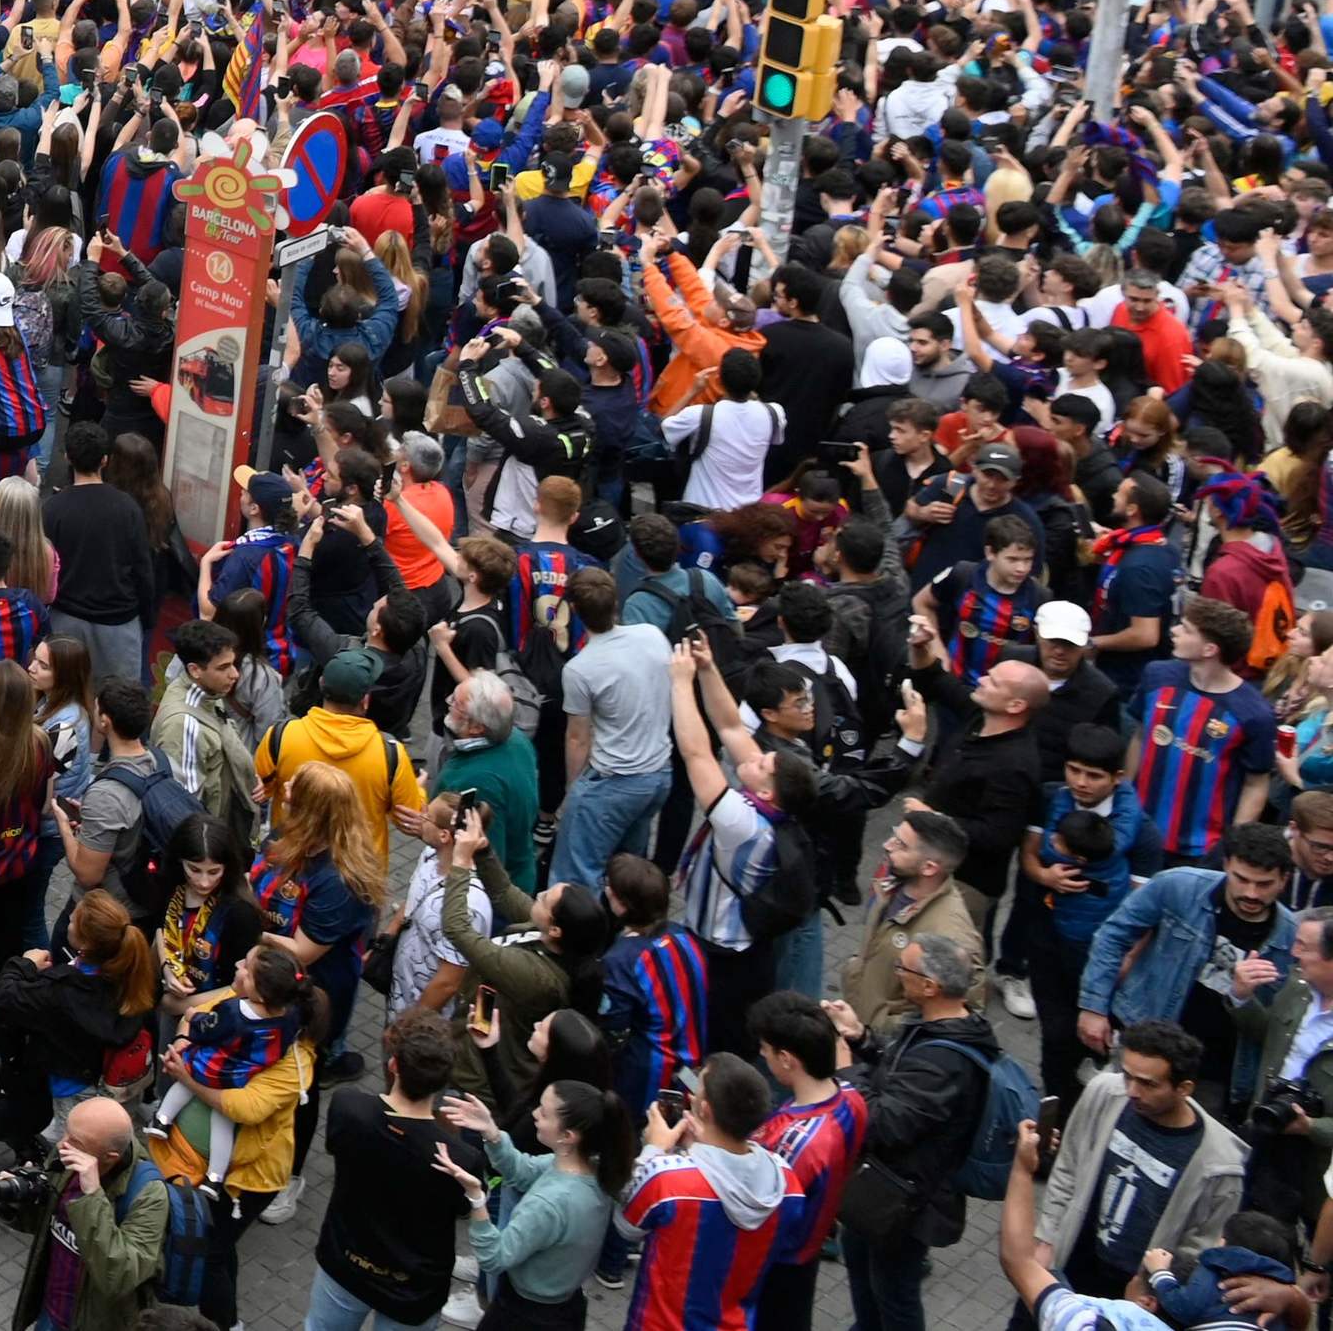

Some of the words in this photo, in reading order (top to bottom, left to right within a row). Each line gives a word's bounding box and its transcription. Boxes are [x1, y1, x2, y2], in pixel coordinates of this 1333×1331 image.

[191, 206, 258, 238] BARCELONA
[211, 255, 230, 278] 14
[190, 280, 220, 301] Camp
[221, 293, 244, 309] Nou
[533, 571, 568, 587] PEDR
